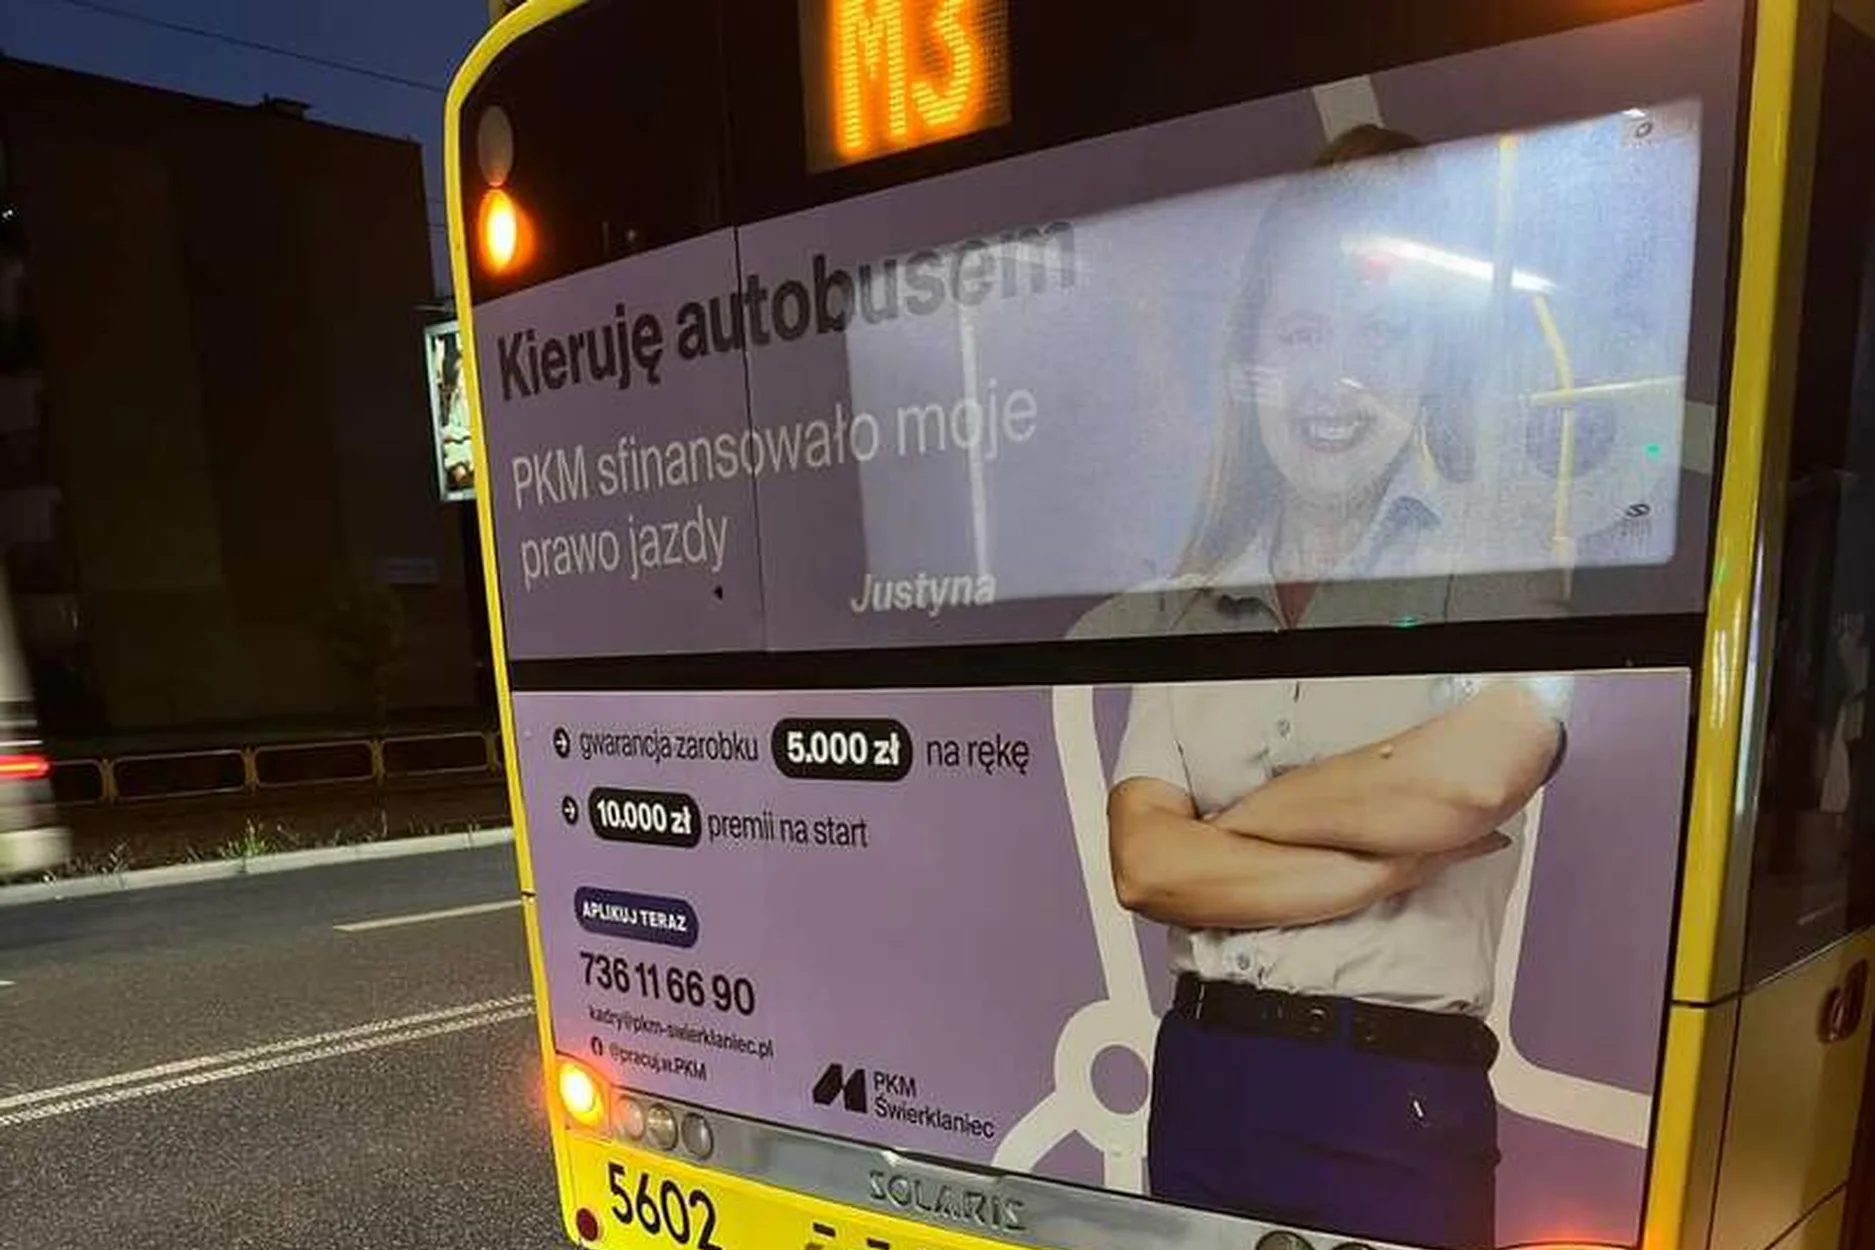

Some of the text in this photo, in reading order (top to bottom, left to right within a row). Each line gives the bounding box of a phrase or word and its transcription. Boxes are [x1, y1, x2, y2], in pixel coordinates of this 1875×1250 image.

[838, 0, 972, 147] M3
[497, 221, 1077, 402] Kieruję autobusem
[513, 377, 1038, 509] PKM sfinansowało moje
[521, 506, 730, 590] prawo jazdy
[850, 572, 997, 618] Justyna
[579, 728, 1029, 775] gwarancja zarobku 5.000 zł na rękę
[597, 799, 868, 848] 10.000 zł premii na start
[582, 901, 687, 934] APLIKUJ TERAZ
[580, 951, 756, 1016] 736 11 66 90
[873, 1071, 917, 1098] PKM
[875, 1093, 995, 1139] Świerklaniec
[868, 1170, 1028, 1231] SOLARIS
